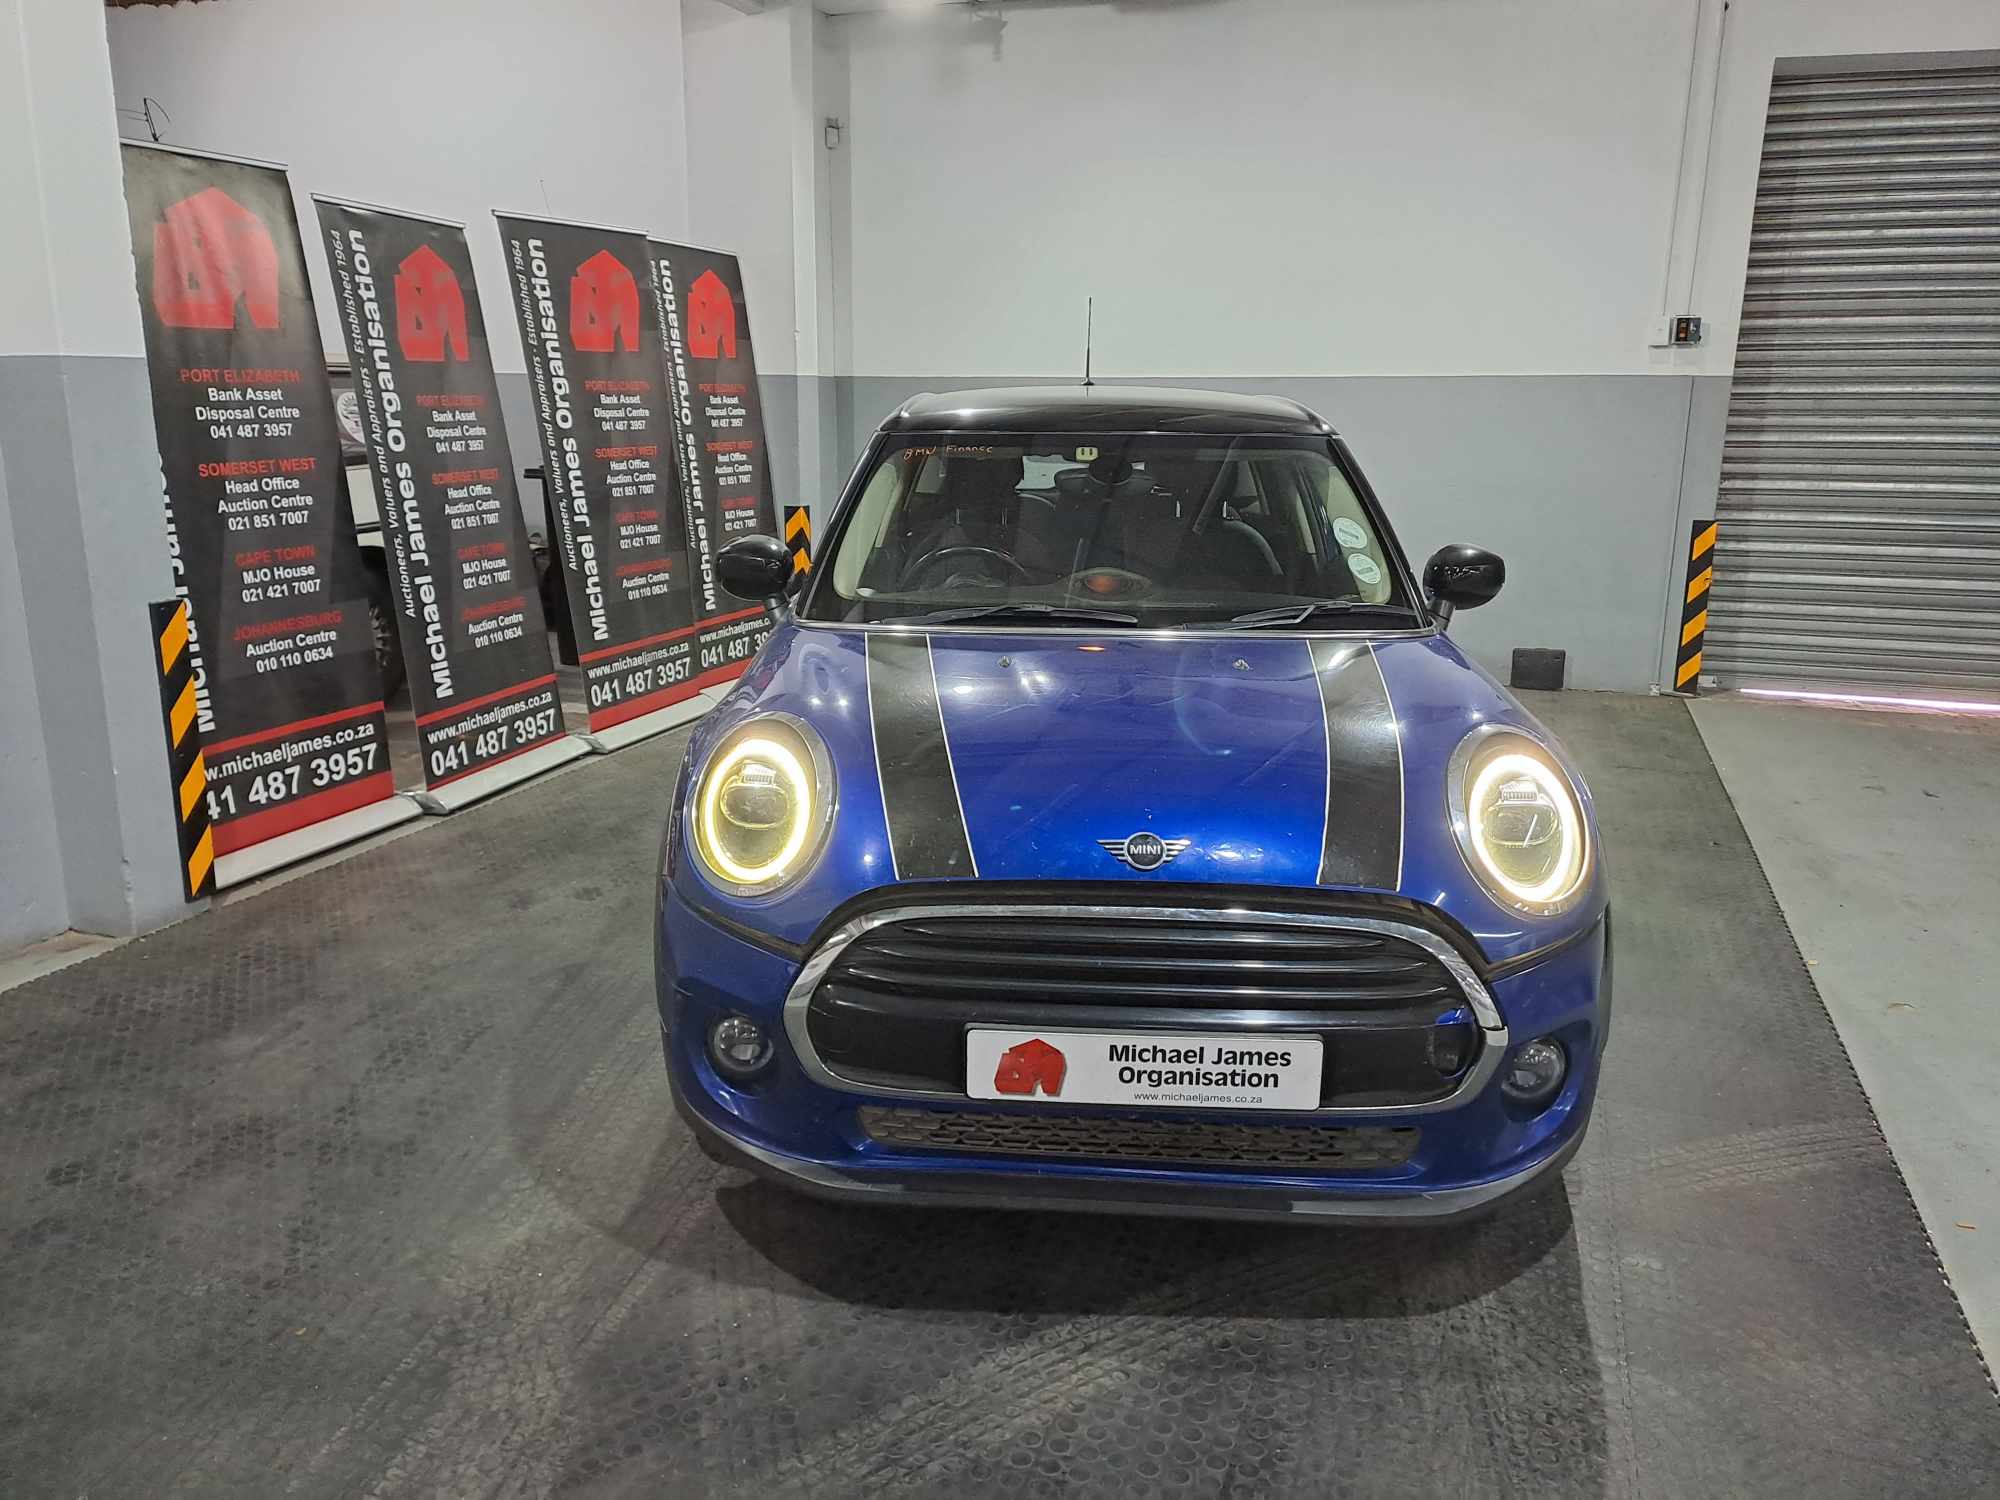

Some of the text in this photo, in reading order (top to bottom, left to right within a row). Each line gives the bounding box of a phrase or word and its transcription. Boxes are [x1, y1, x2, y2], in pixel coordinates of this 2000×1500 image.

[331, 229, 347, 267] 1964
[511, 239, 525, 271] 1964
[338, 269, 364, 354] Established
[516, 273, 538, 346] Established
[180, 368, 299, 383] PORT ELIZABETH
[207, 388, 283, 401] Bank Asset
[533, 356, 551, 421] Appraisers
[195, 405, 300, 422] Disposal Centre
[360, 367, 383, 443] Appraisers
[432, 410, 454, 422] Bank
[210, 423, 293, 439] 041 487 3957
[427, 425, 462, 440] Disposal
[528, 238, 609, 641] Michael James Organisation
[543, 422, 555, 447] and
[660, 260, 716, 611] Michael James Organisation
[198, 457, 317, 478] SOMERSET WEST
[349, 229, 454, 699] Michael James Organisation
[376, 445, 389, 474] and
[550, 450, 565, 494] Valuers
[225, 477, 300, 494] Head Office
[633, 472, 656, 482] Centre
[382, 477, 399, 529] Valuers
[469, 485, 492, 496] Office
[217, 494, 313, 514] Auction Centre
[444, 499, 501, 515] Auction Centre
[228, 511, 309, 531] 021 851 7007
[235, 545, 315, 566] CAPE TOWN
[481, 559, 507, 570] House
[243, 564, 315, 585] MJO House
[242, 579, 321, 603] 021 421 7007
[234, 611, 342, 640] JOHANNESBURG
[468, 620, 497, 635] Auction
[246, 629, 337, 657] Auction Centre
[701, 644, 724, 668] 041
[728, 637, 750, 659] 487
[256, 646, 334, 673] 010 110 0634
[587, 642, 689, 680] www.michaeljames.co.za
[591, 657, 691, 707] 041 487 3957
[427, 692, 552, 745] www.michaeljames.co.za
[204, 723, 375, 782] w.michaeljames.co.za
[430, 708, 555, 777] 041 487 3957
[205, 743, 377, 820] 41 487 3957
[1130, 844, 1161, 854] MINI
[1109, 1044, 1292, 1067] Michael James
[1118, 1066, 1279, 1088] Organisation
[1133, 1092, 1263, 1105] www.michaeljames.co.za
